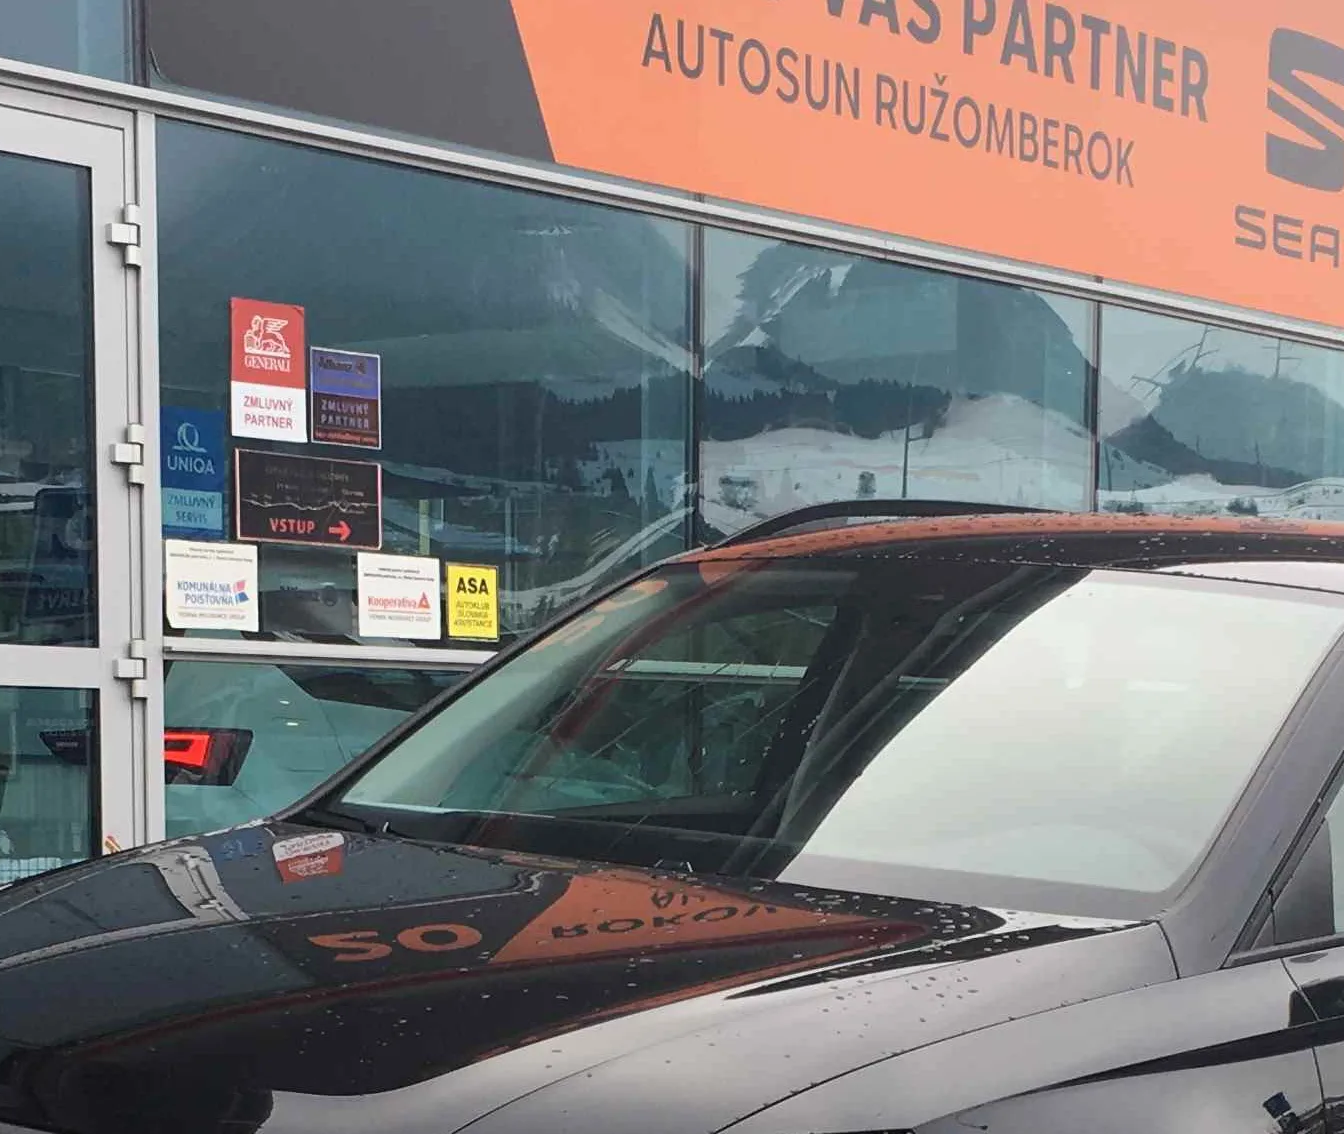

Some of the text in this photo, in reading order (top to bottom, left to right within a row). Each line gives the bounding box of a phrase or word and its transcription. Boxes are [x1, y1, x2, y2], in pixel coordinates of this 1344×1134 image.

[962, 0, 1208, 123] PARTNER
[641, 12, 1135, 188] AUTOSUN RUŽOMBEROK
[244, 355, 291, 373] GENERALI
[243, 395, 294, 415] ZMLUVNÝ
[244, 413, 293, 430] PARTNER
[321, 413, 369, 430] PARTNER
[167, 454, 216, 475] UNIQA
[269, 517, 316, 534] VSTUP
[456, 576, 489, 596] ASA
